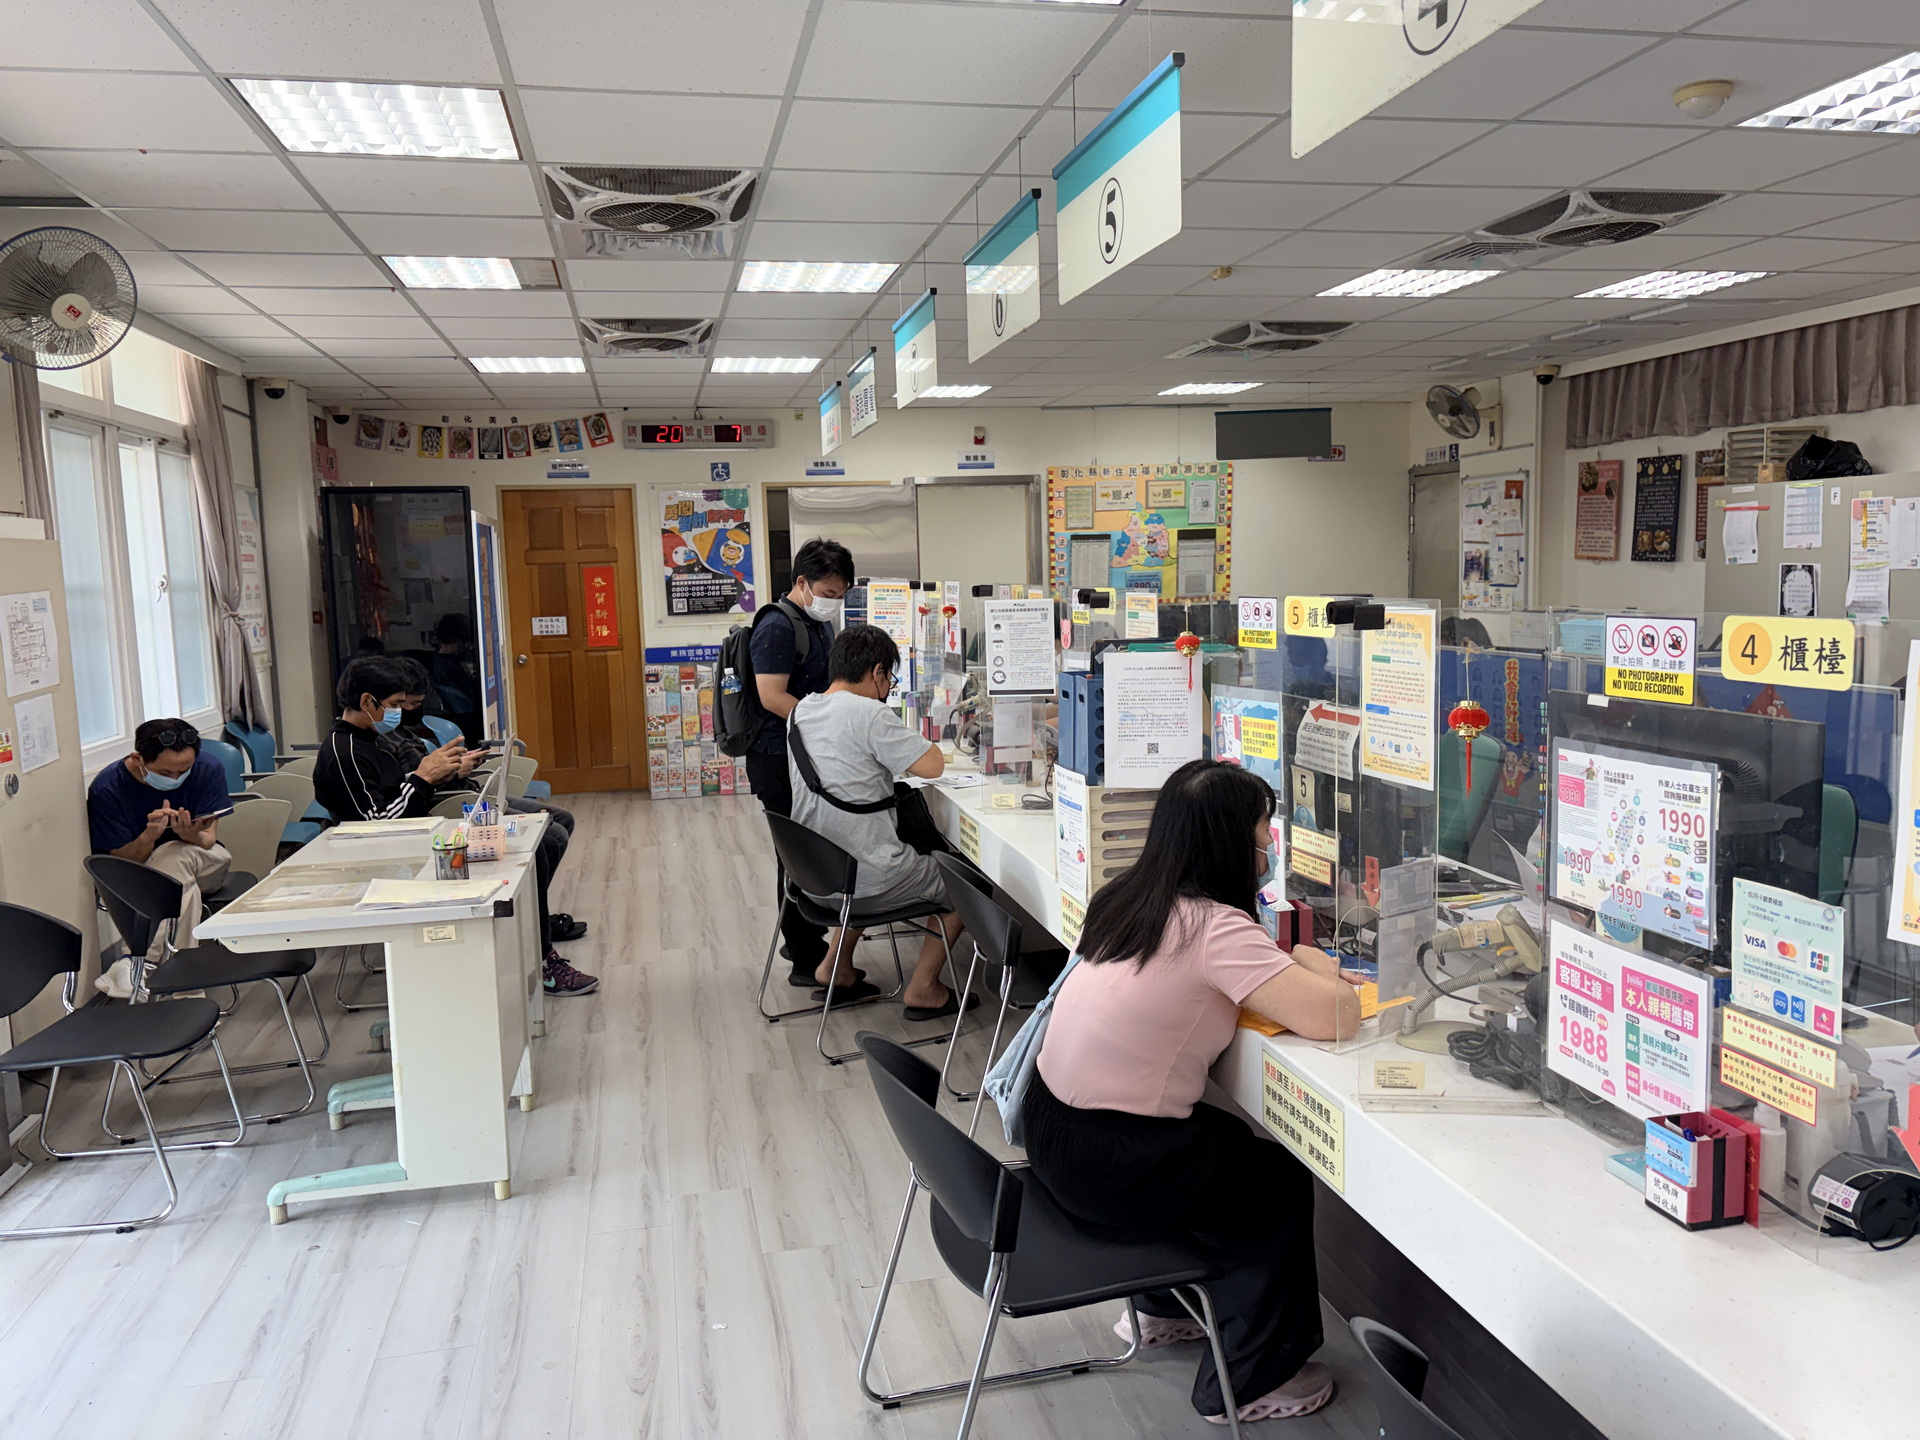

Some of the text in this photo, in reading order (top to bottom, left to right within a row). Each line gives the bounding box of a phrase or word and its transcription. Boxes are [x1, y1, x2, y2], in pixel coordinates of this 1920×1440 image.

[1105, 188, 1117, 254] 5
[441, 415, 519, 424] 彰化美食
[627, 425, 637, 437] 請
[655, 425, 683, 443] 20
[731, 424, 741, 442] 7
[1060, 464, 1219, 479] 彰化縣新住民福利資源地圖
[1055, 490, 1064, 517] 工作
[1217, 477, 1227, 525] 社福據點
[1833, 492, 1838, 501] F
[592, 577, 611, 637] 恭賀新禧
[1292, 606, 1300, 625] 5
[1250, 629, 1271, 638] PHOTOGRAPHY
[1612, 655, 1686, 671] 禁止拍照、禁止錄影
[1740, 633, 1847, 675] 4 櫃檯
[1617, 669, 1679, 683] NO PHOTOGRAPHY
[1612, 679, 1685, 697] NO VIDEO RECORDING
[1505, 658, 1519, 745] 我會好運
[1299, 774, 1307, 798] 5
[1560, 787, 1581, 804] 1990
[1657, 778, 1709, 795] 外來人士在臺生活
[1663, 790, 1702, 804] 諮詢服務熱線
[1658, 808, 1706, 839] 1990
[1563, 850, 1592, 874] 1990
[1610, 883, 1643, 909] 1990
[1600, 912, 1617, 927] FREE
[1744, 933, 1767, 950] VISA
[1810, 951, 1830, 973] JCB
[1559, 964, 1602, 1002] 客服上線
[1568, 997, 1596, 1023] 諮詢撥打
[1625, 986, 1695, 1032] 本人親領攜帶
[1793, 1011, 1803, 1021] NFC
[1559, 1014, 1609, 1064] 1988
[1653, 1176, 1679, 1200] 號碼牌
[1653, 1193, 1679, 1217] 回收桶
